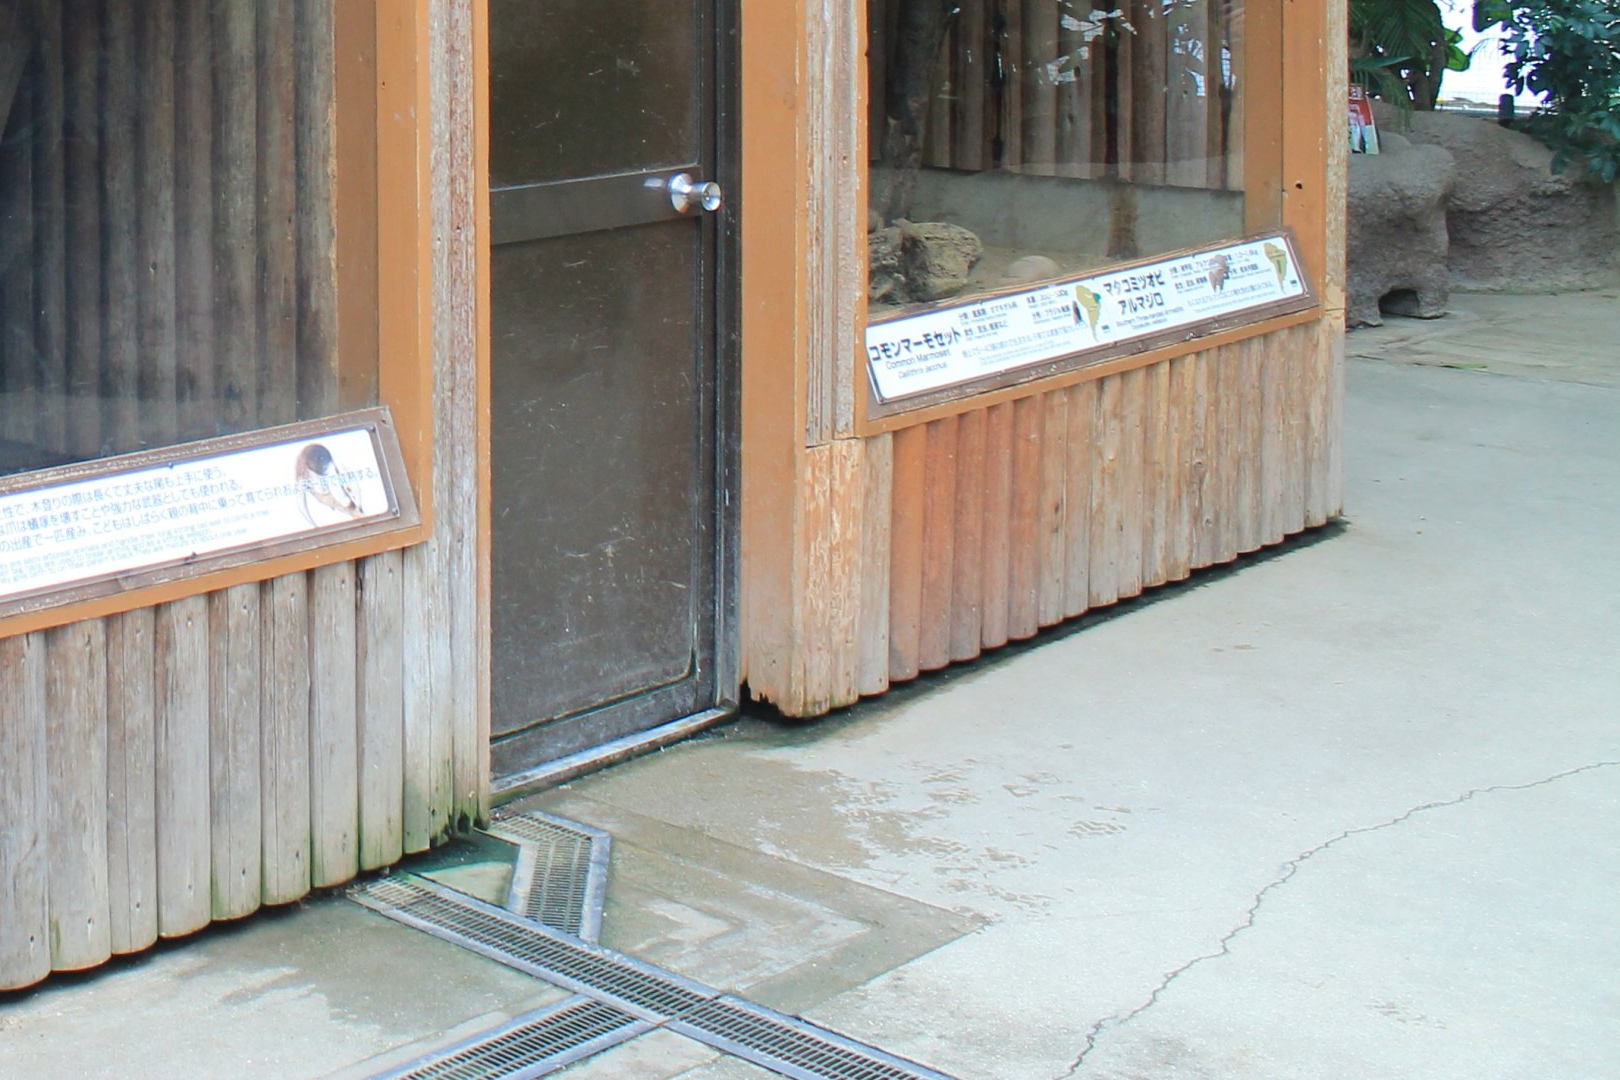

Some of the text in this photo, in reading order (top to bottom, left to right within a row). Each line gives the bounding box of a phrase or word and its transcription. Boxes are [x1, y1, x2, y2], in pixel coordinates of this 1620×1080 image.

[1103, 270, 1166, 296] マタコミツオビ
[1118, 292, 1166, 317] アルマジロ
[869, 326, 962, 362] コモンマーモセット
